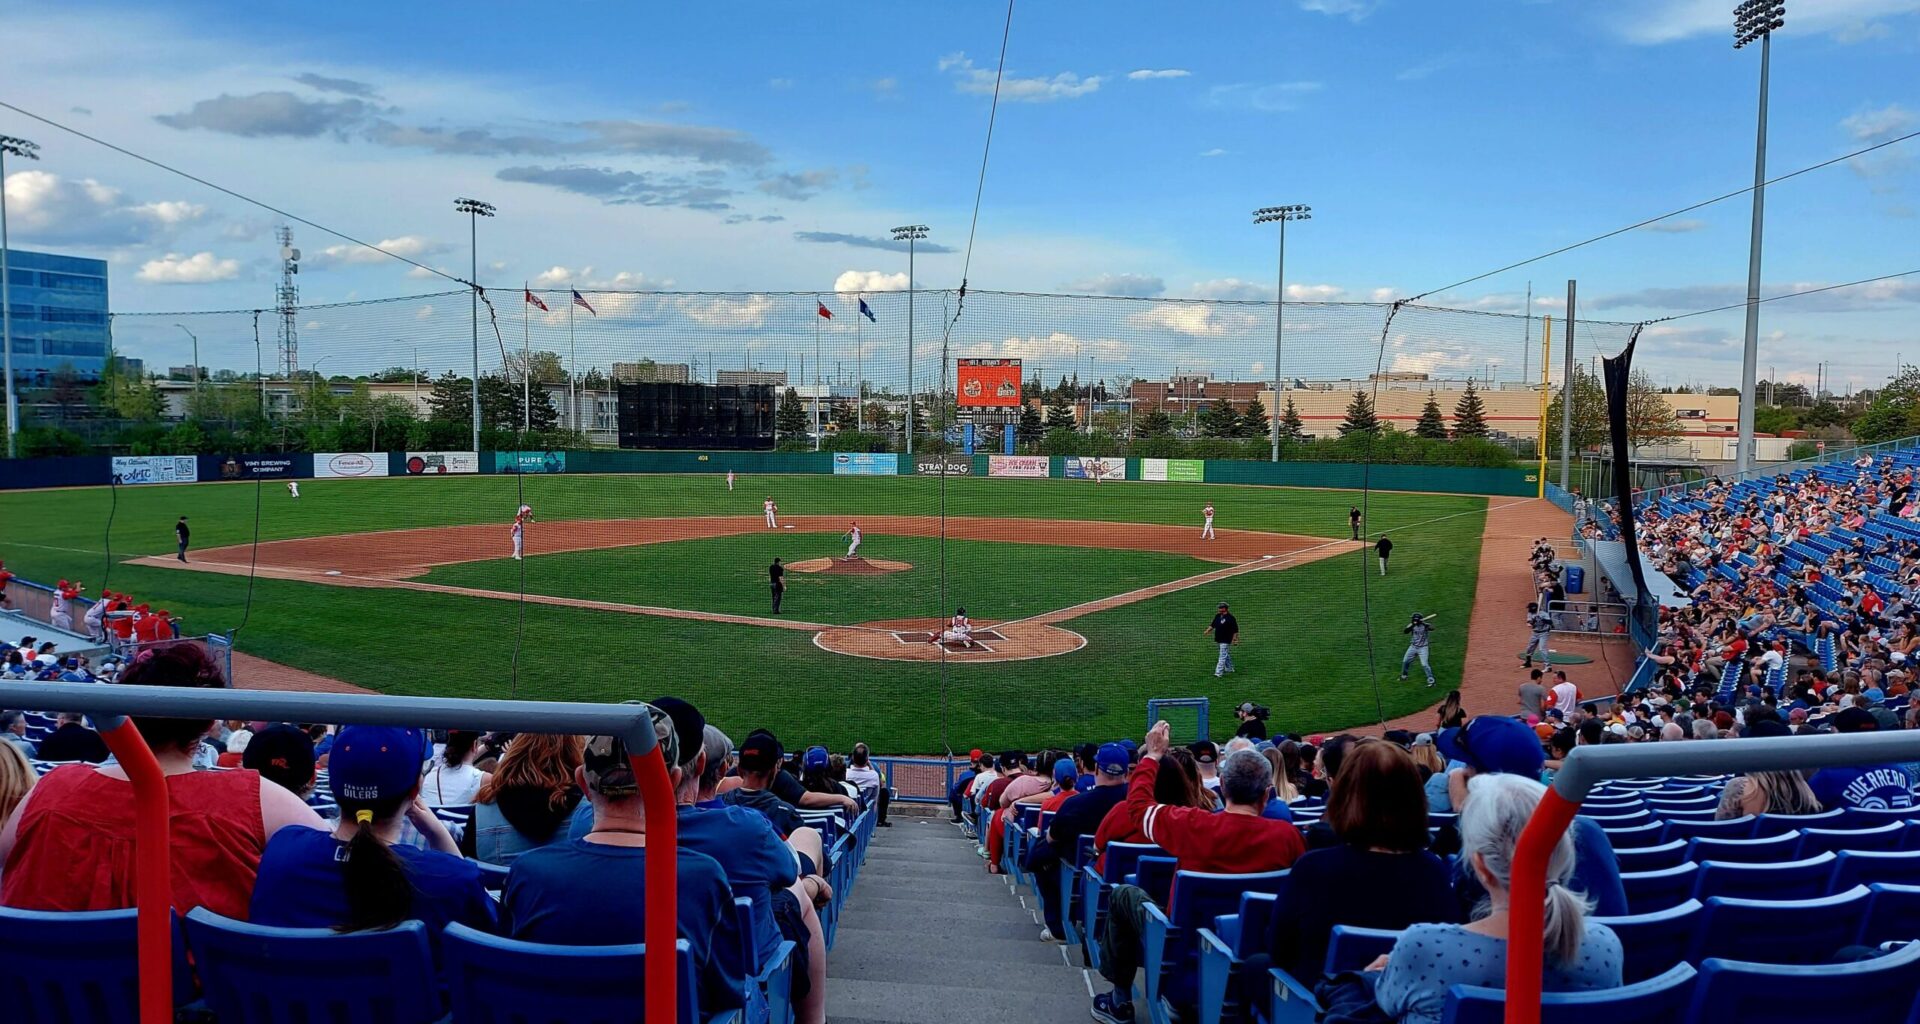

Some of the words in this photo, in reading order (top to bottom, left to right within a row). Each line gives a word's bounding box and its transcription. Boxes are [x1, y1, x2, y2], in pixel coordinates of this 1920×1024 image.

[918, 463, 944, 472] STRAY
[947, 463, 968, 472] DOG
[1842, 768, 1906, 804] GUERRERO
[344, 788, 378, 799] OILERS
